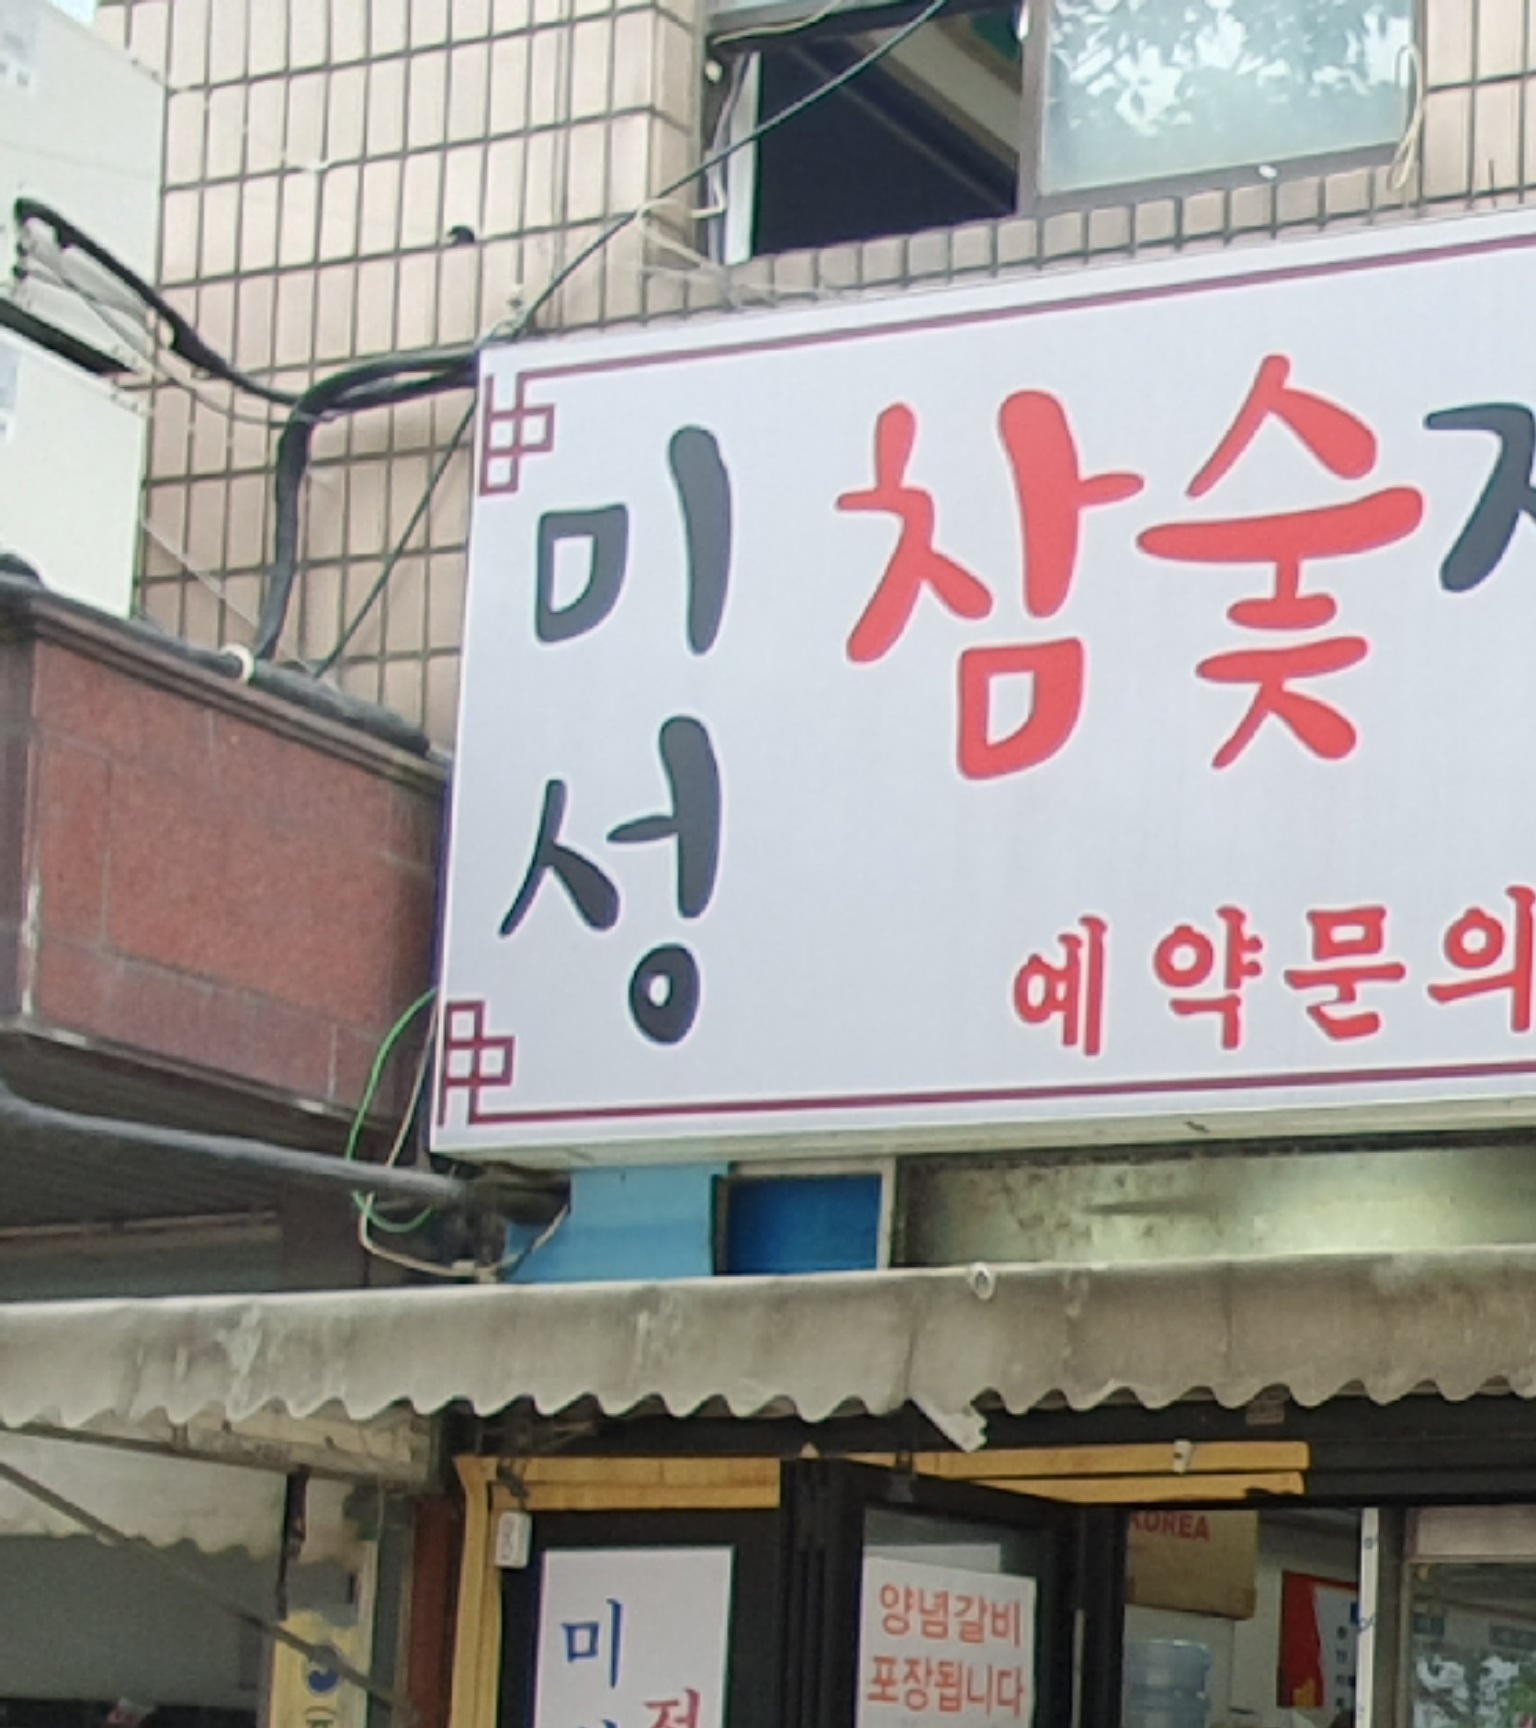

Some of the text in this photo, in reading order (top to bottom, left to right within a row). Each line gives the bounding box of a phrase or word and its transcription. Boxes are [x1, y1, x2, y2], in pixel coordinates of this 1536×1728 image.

[498, 423, 733, 1045] 미성
[1011, 885, 1536, 1056] 예약문의
[879, 1582, 1022, 1648] 양념갈비
[867, 1656, 1024, 1717] 포장됩니다
